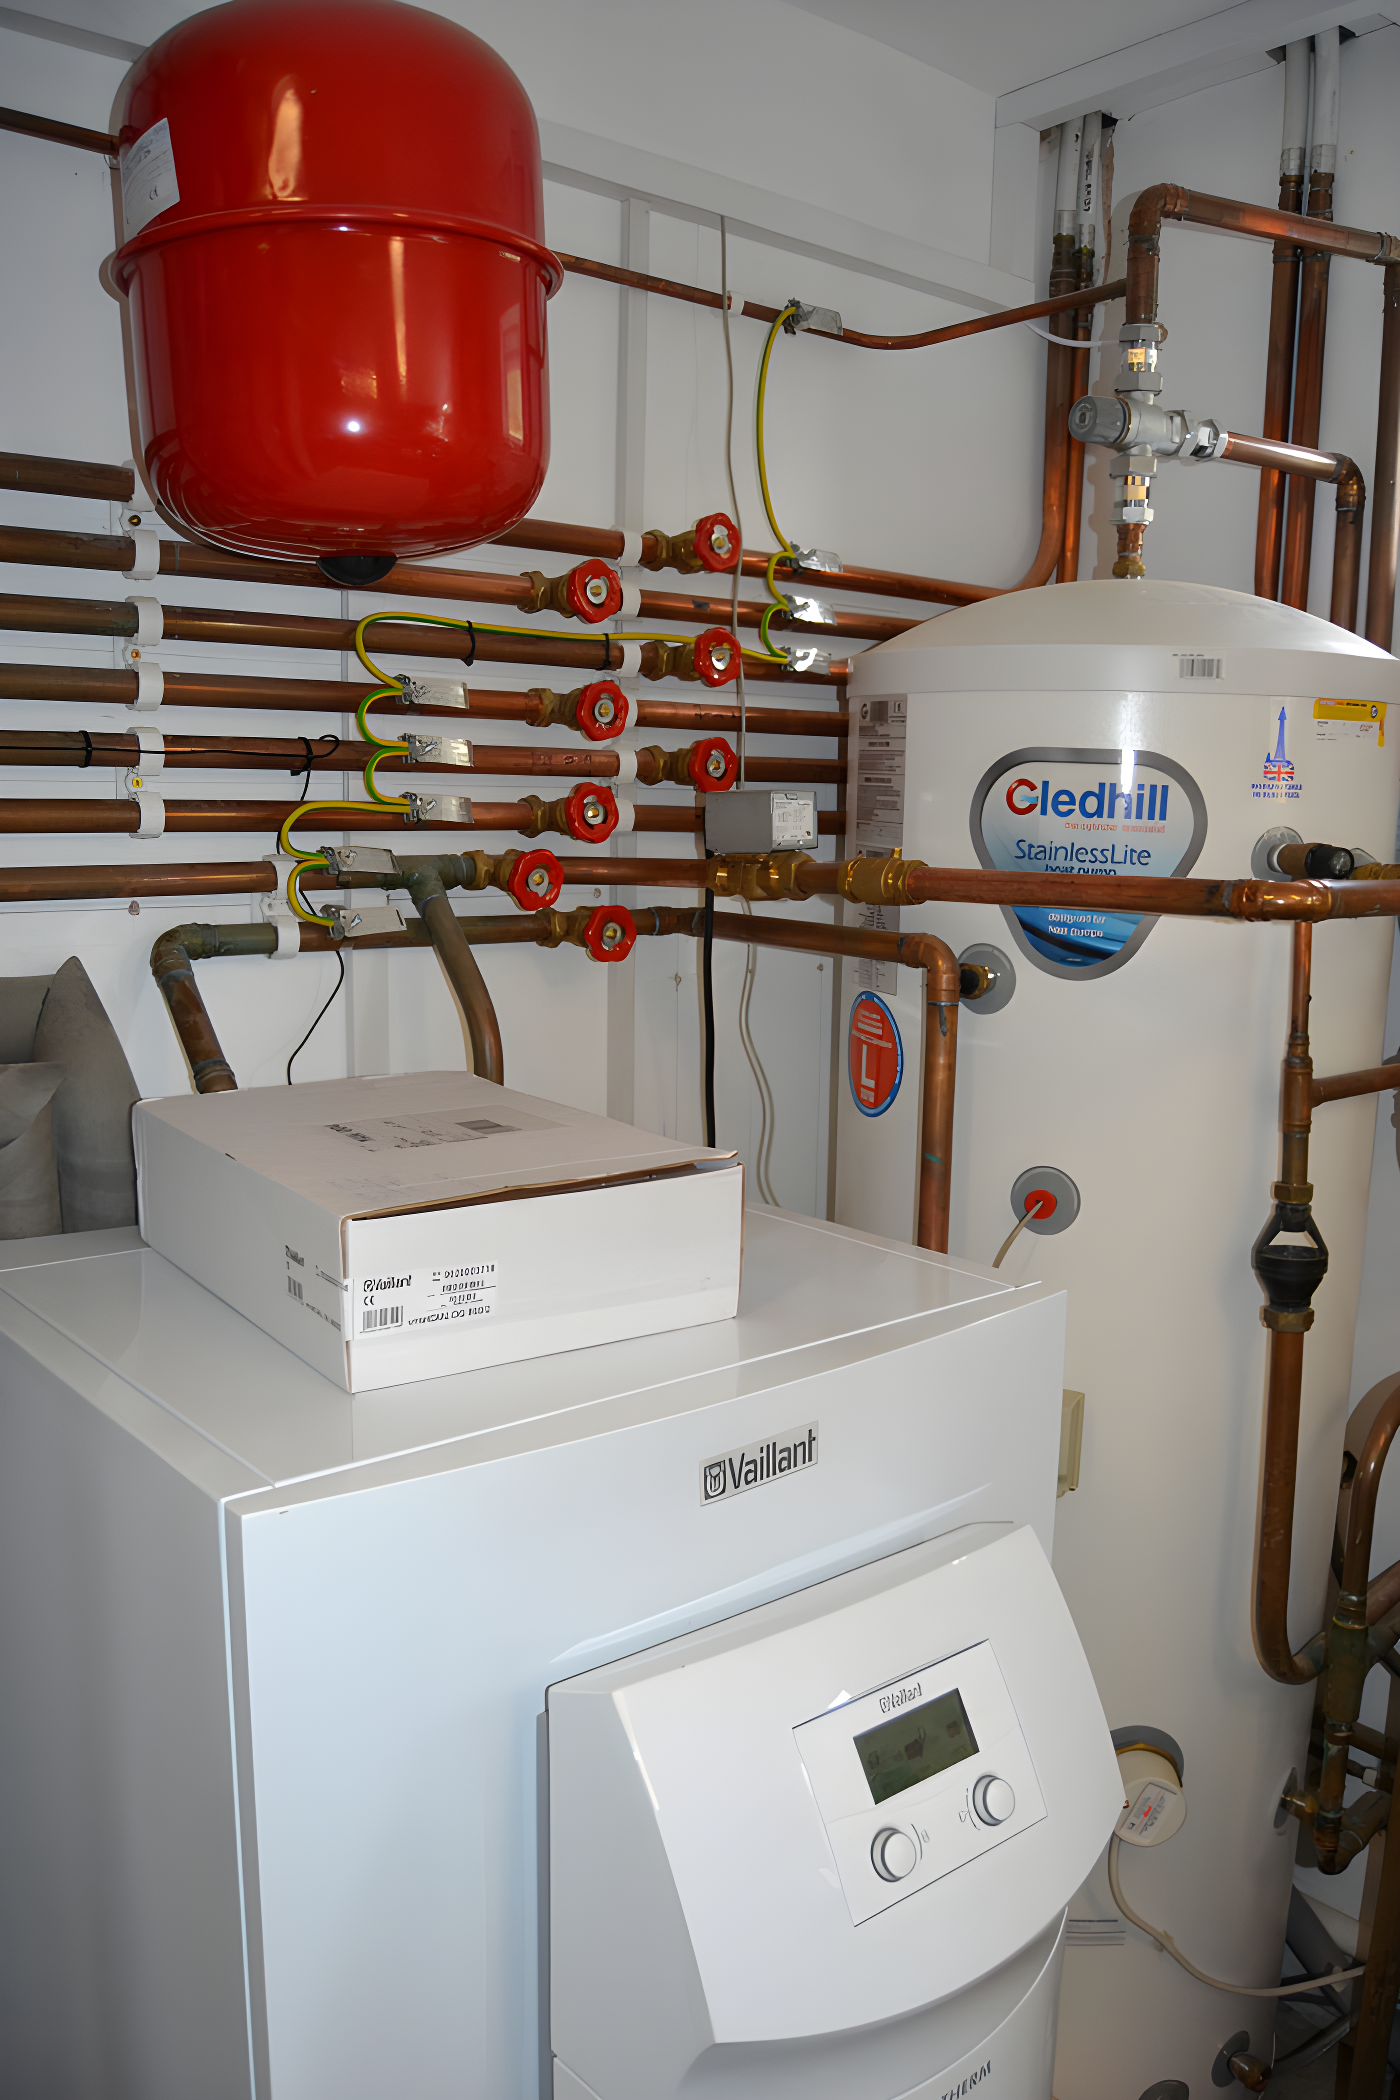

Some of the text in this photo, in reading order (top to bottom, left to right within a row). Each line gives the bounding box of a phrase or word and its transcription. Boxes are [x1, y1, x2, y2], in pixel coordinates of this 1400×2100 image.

[1005, 778, 1169, 821] Gledhill
[1014, 838, 1151, 866] StainlessLite
[728, 1428, 816, 1490] Vaillant
